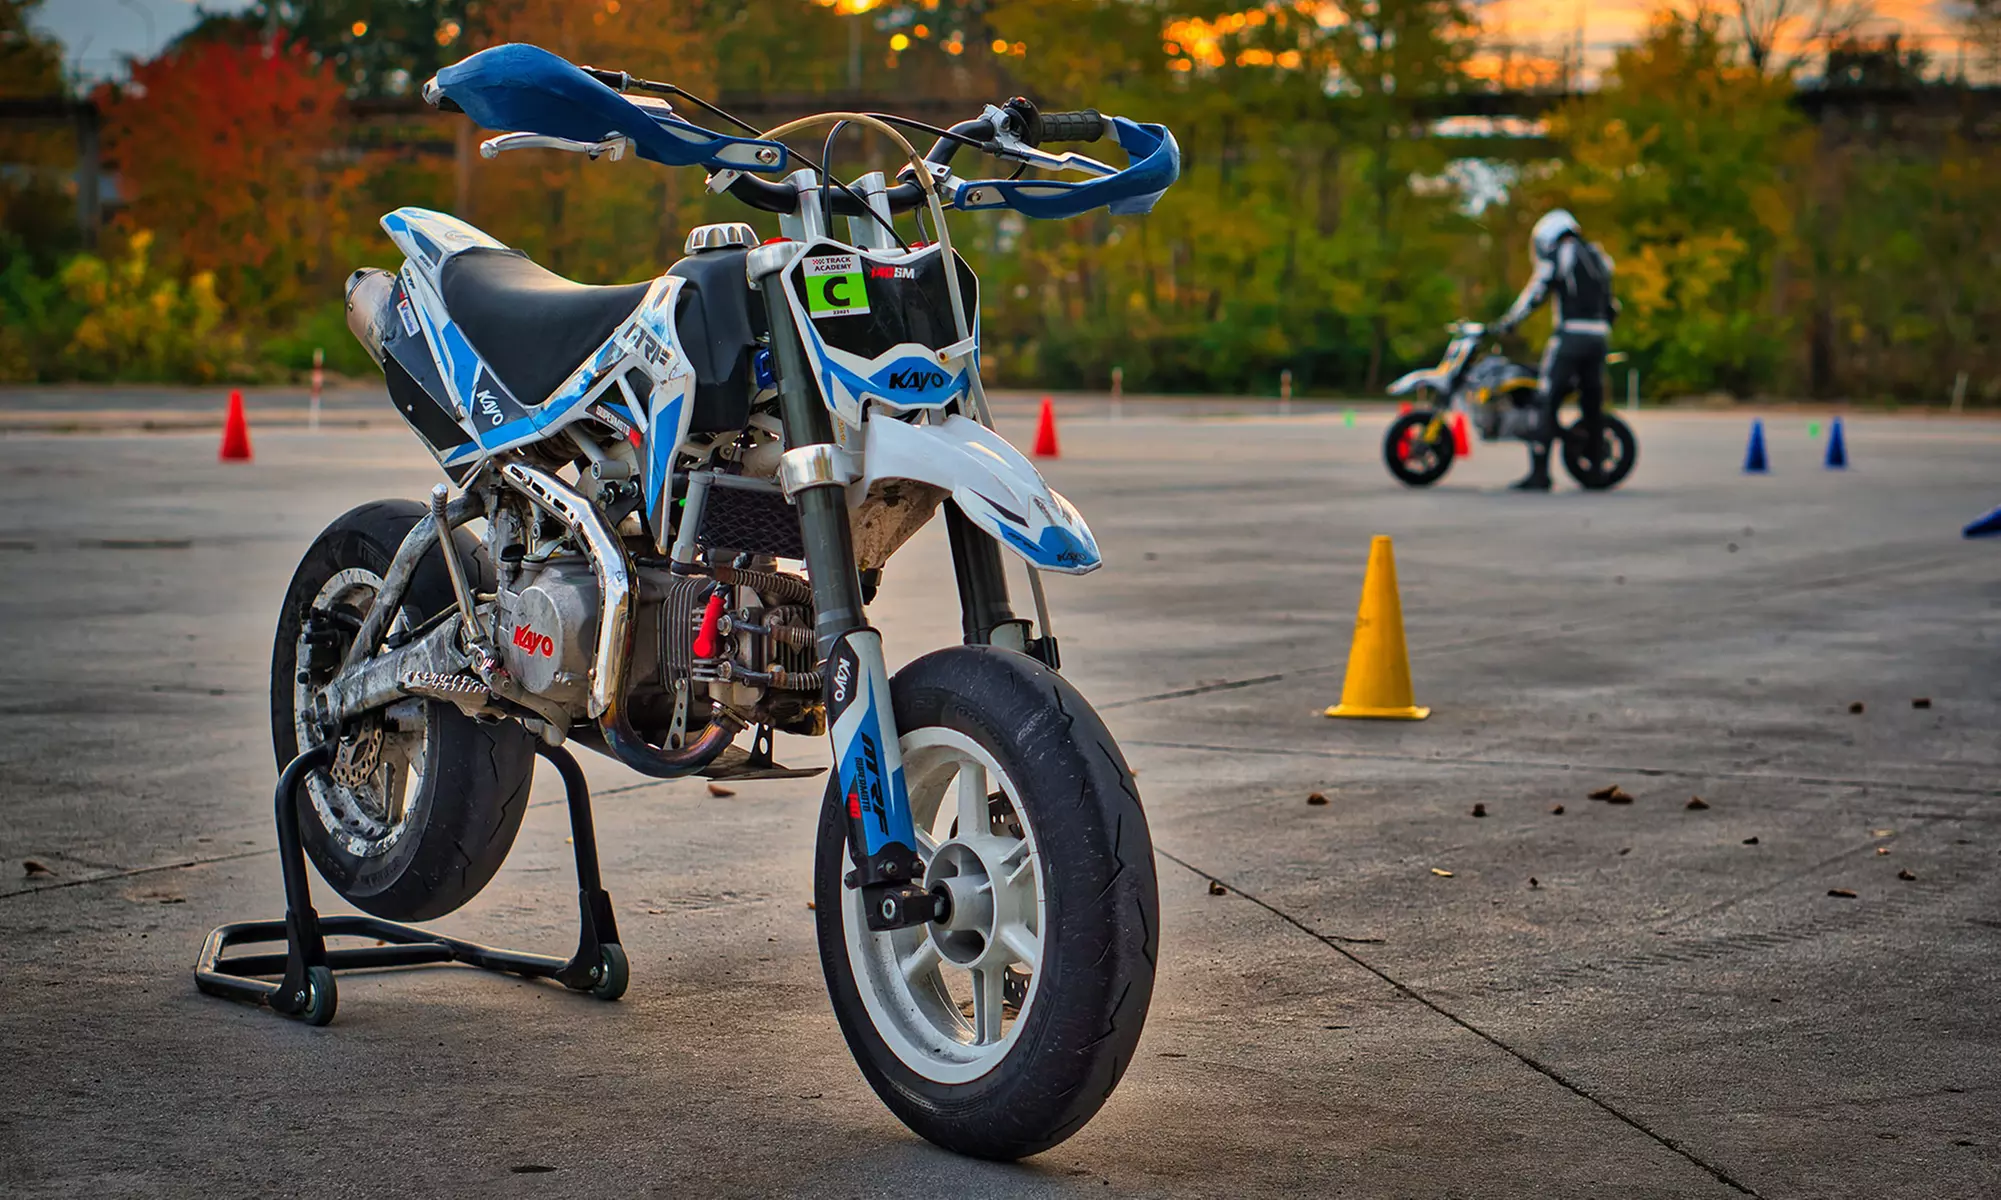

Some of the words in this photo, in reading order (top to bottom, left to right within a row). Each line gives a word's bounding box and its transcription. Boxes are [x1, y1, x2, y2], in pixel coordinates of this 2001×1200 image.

[815, 263, 852, 272] ACADEMY
[826, 256, 851, 264] TRACK
[823, 276, 851, 307] C
[889, 367, 944, 392] KAYO
[476, 389, 504, 426] KAYO
[513, 622, 554, 658] KAYO
[834, 657, 851, 702] KAYO
[854, 756, 871, 812] SUPERMOTO
